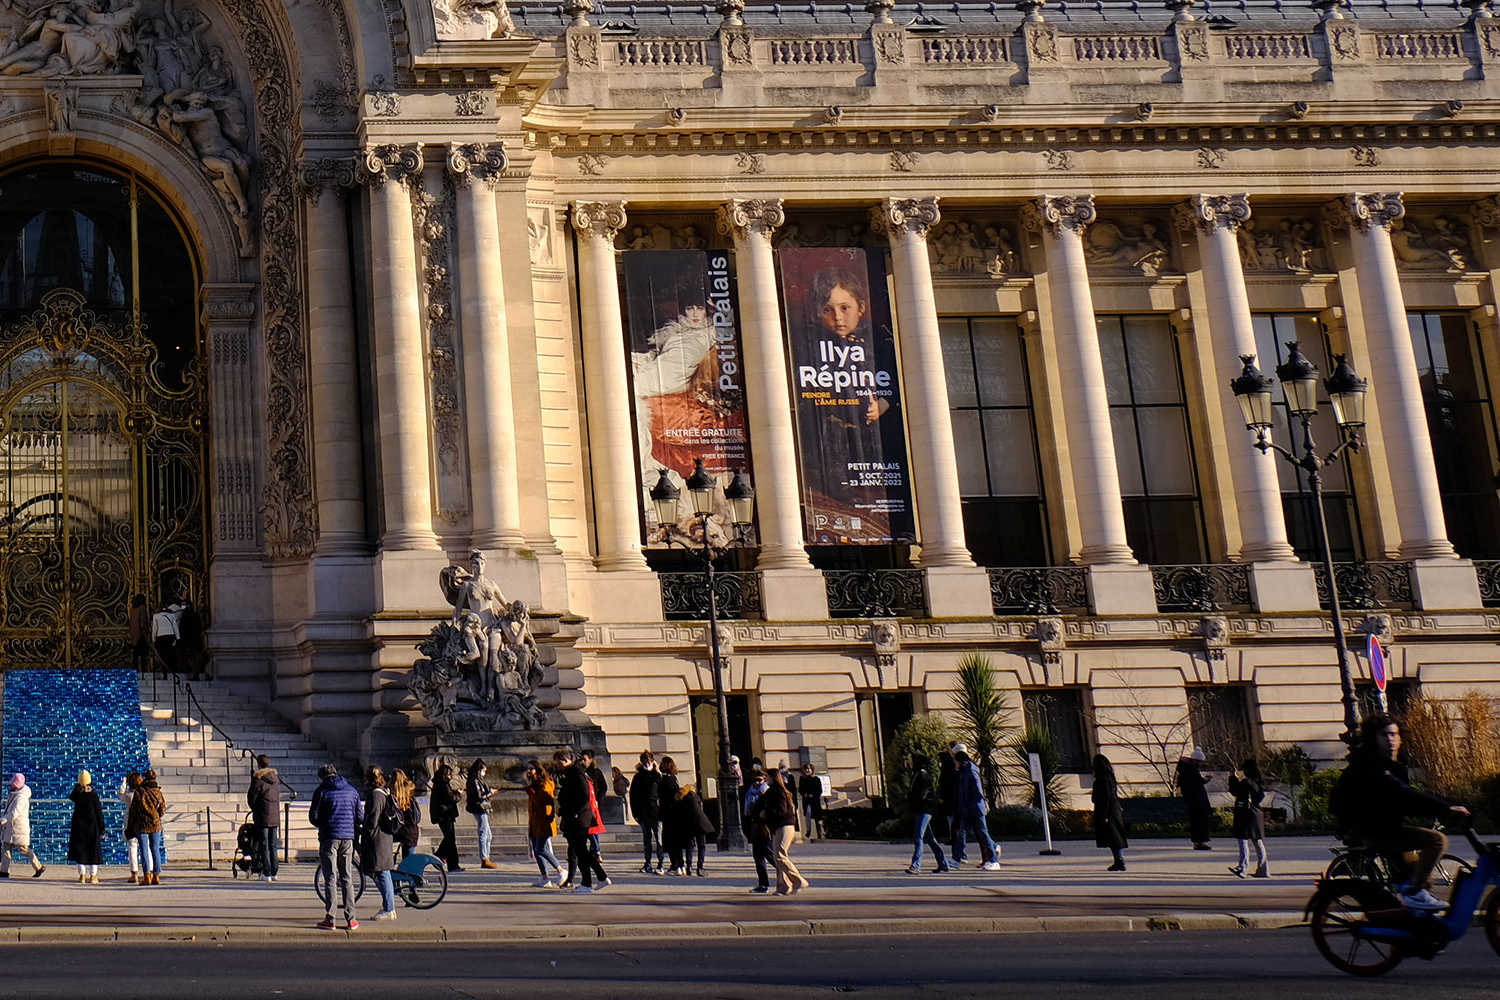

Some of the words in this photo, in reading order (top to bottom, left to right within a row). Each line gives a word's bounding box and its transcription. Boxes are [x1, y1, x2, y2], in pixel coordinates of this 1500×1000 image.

[708, 256, 732, 326] Palais
[716, 333, 738, 392] Petit
[820, 341, 865, 367] Ilya
[799, 364, 890, 393] Répine
[666, 427, 700, 436] ENTRÉE
